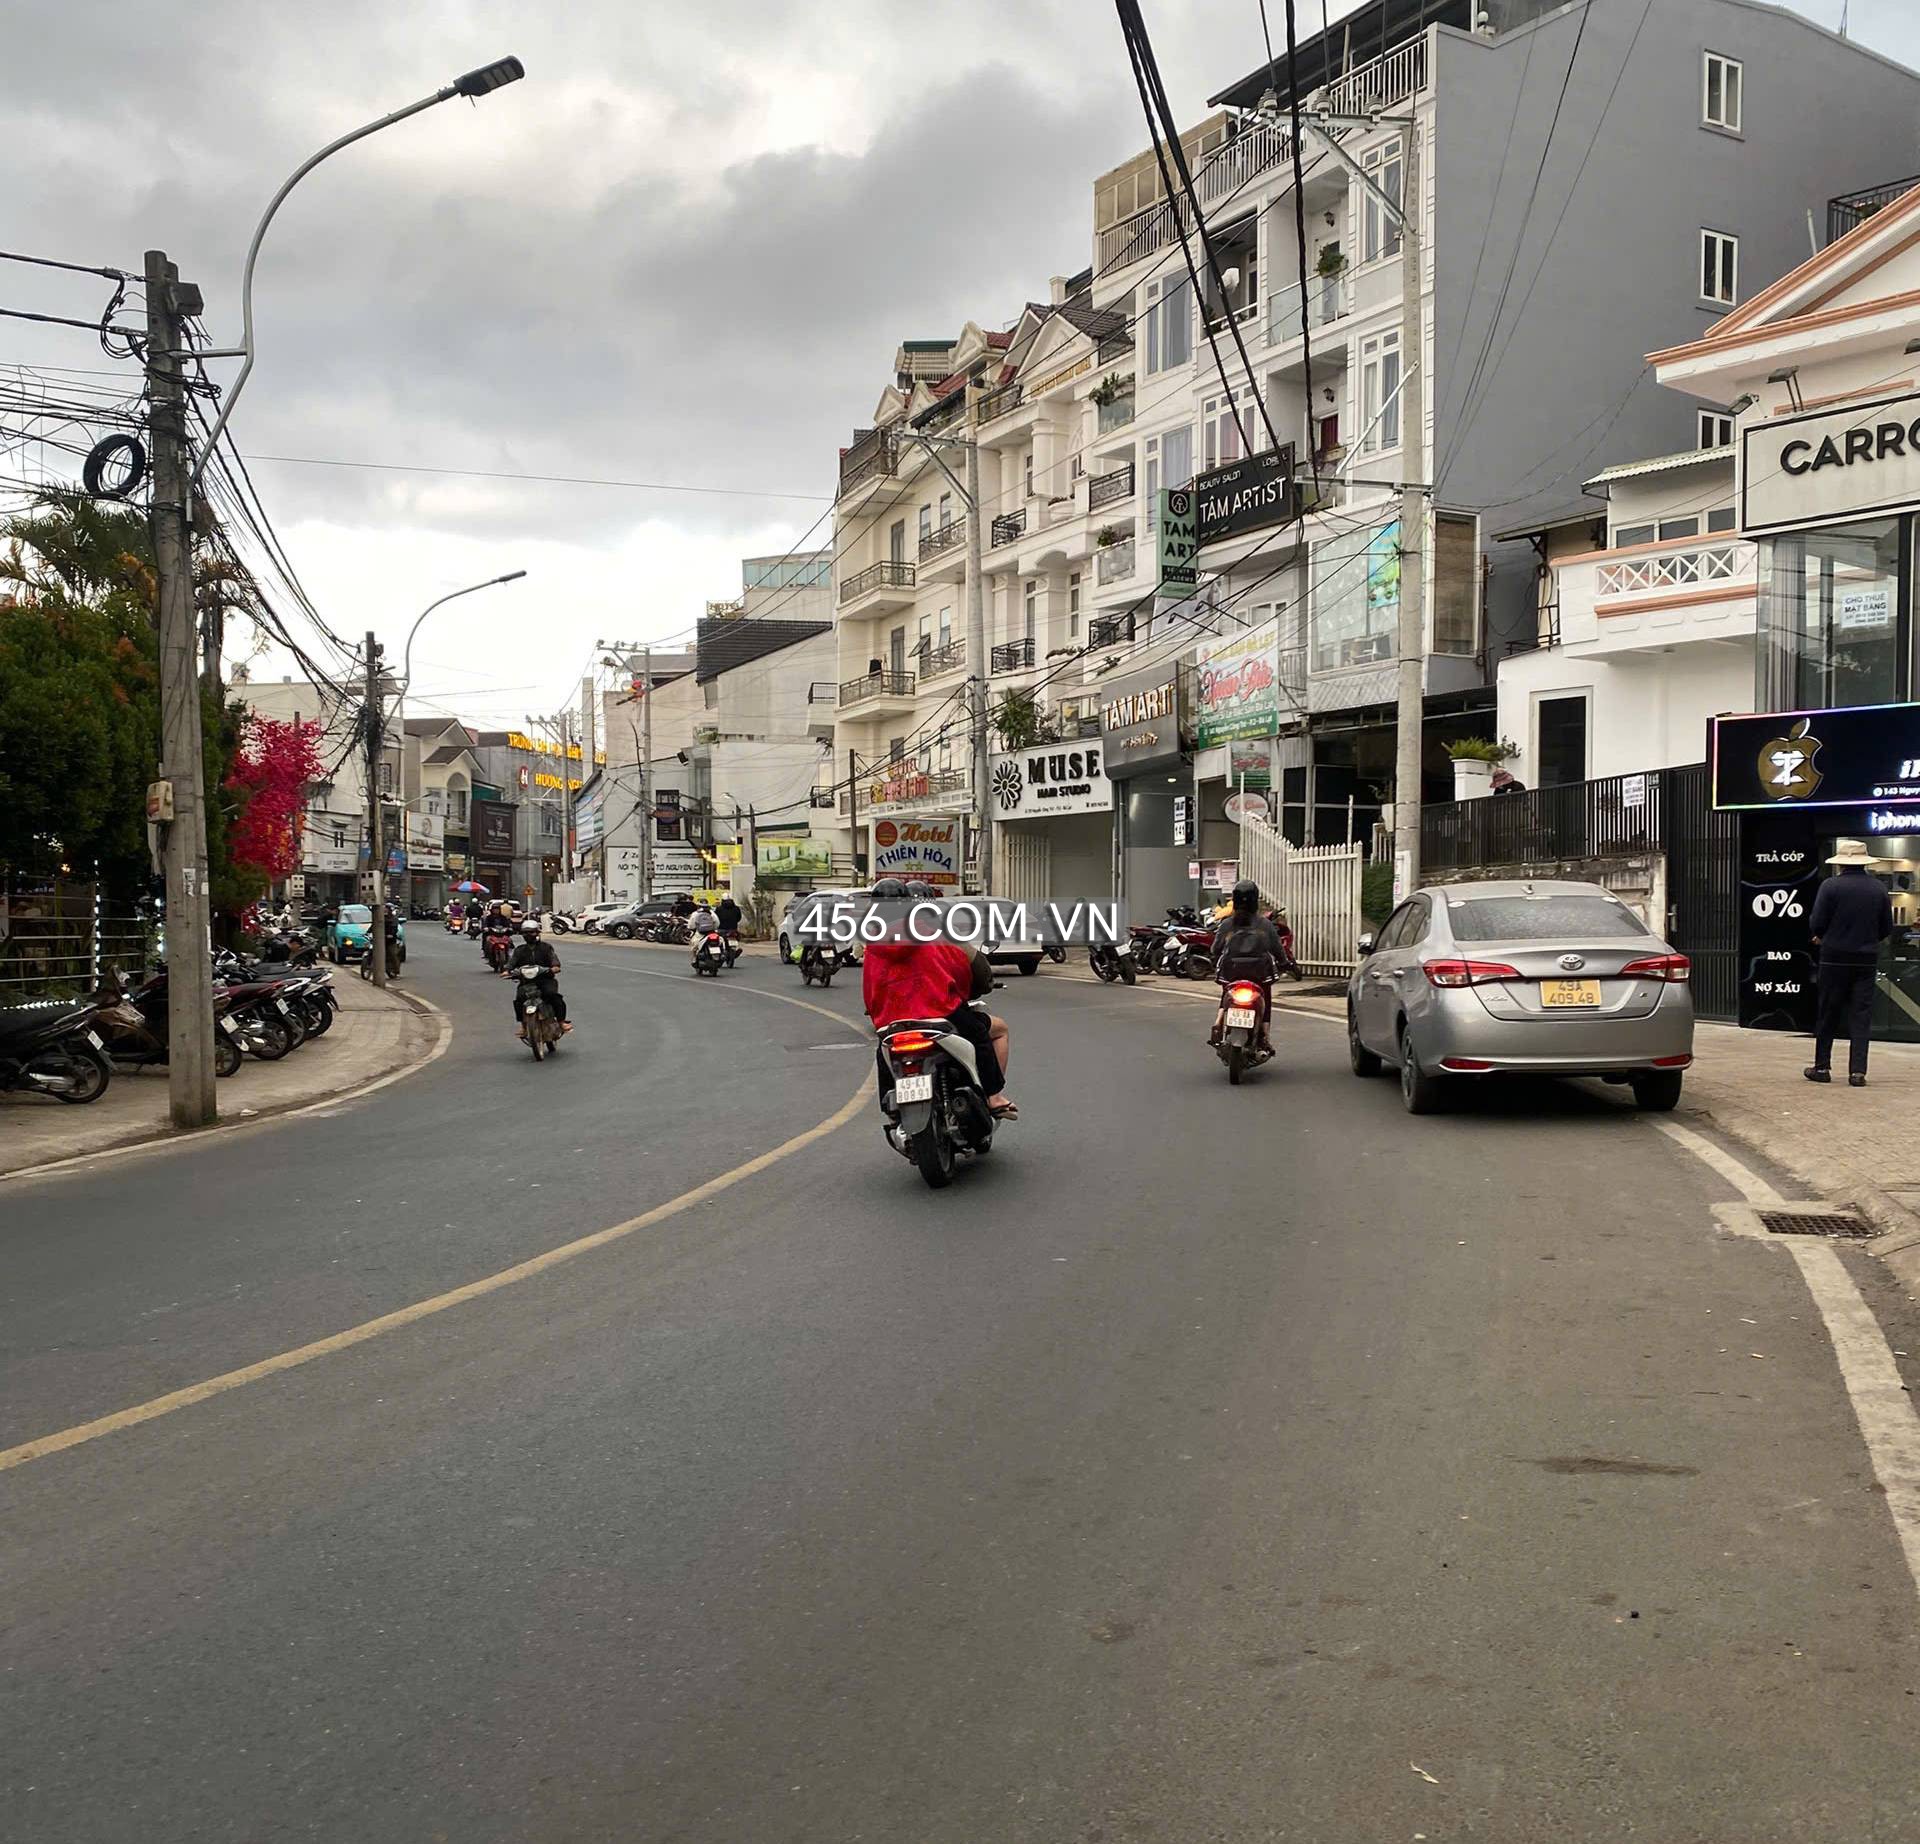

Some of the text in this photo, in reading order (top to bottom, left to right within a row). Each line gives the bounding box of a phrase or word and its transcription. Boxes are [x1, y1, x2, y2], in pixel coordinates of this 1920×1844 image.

[1222, 470, 1242, 485] SALON
[1200, 476, 1288, 523] TÂM ARTIST
[1163, 521, 1196, 539] TAM
[1164, 542, 1196, 559] ART
[1027, 749, 1100, 785] MUSE
[1037, 783, 1091, 799] HAIR STUDIO
[900, 823, 954, 843] Hotel
[876, 845, 917, 868] THIÊN
[1756, 850, 1805, 863] TRẢ GÓP
[1752, 889, 1803, 918] 0%
[1767, 951, 1792, 961] BAO
[1755, 980, 1801, 995] NỢ XẤU
[1549, 992, 1594, 1005] 409.48
